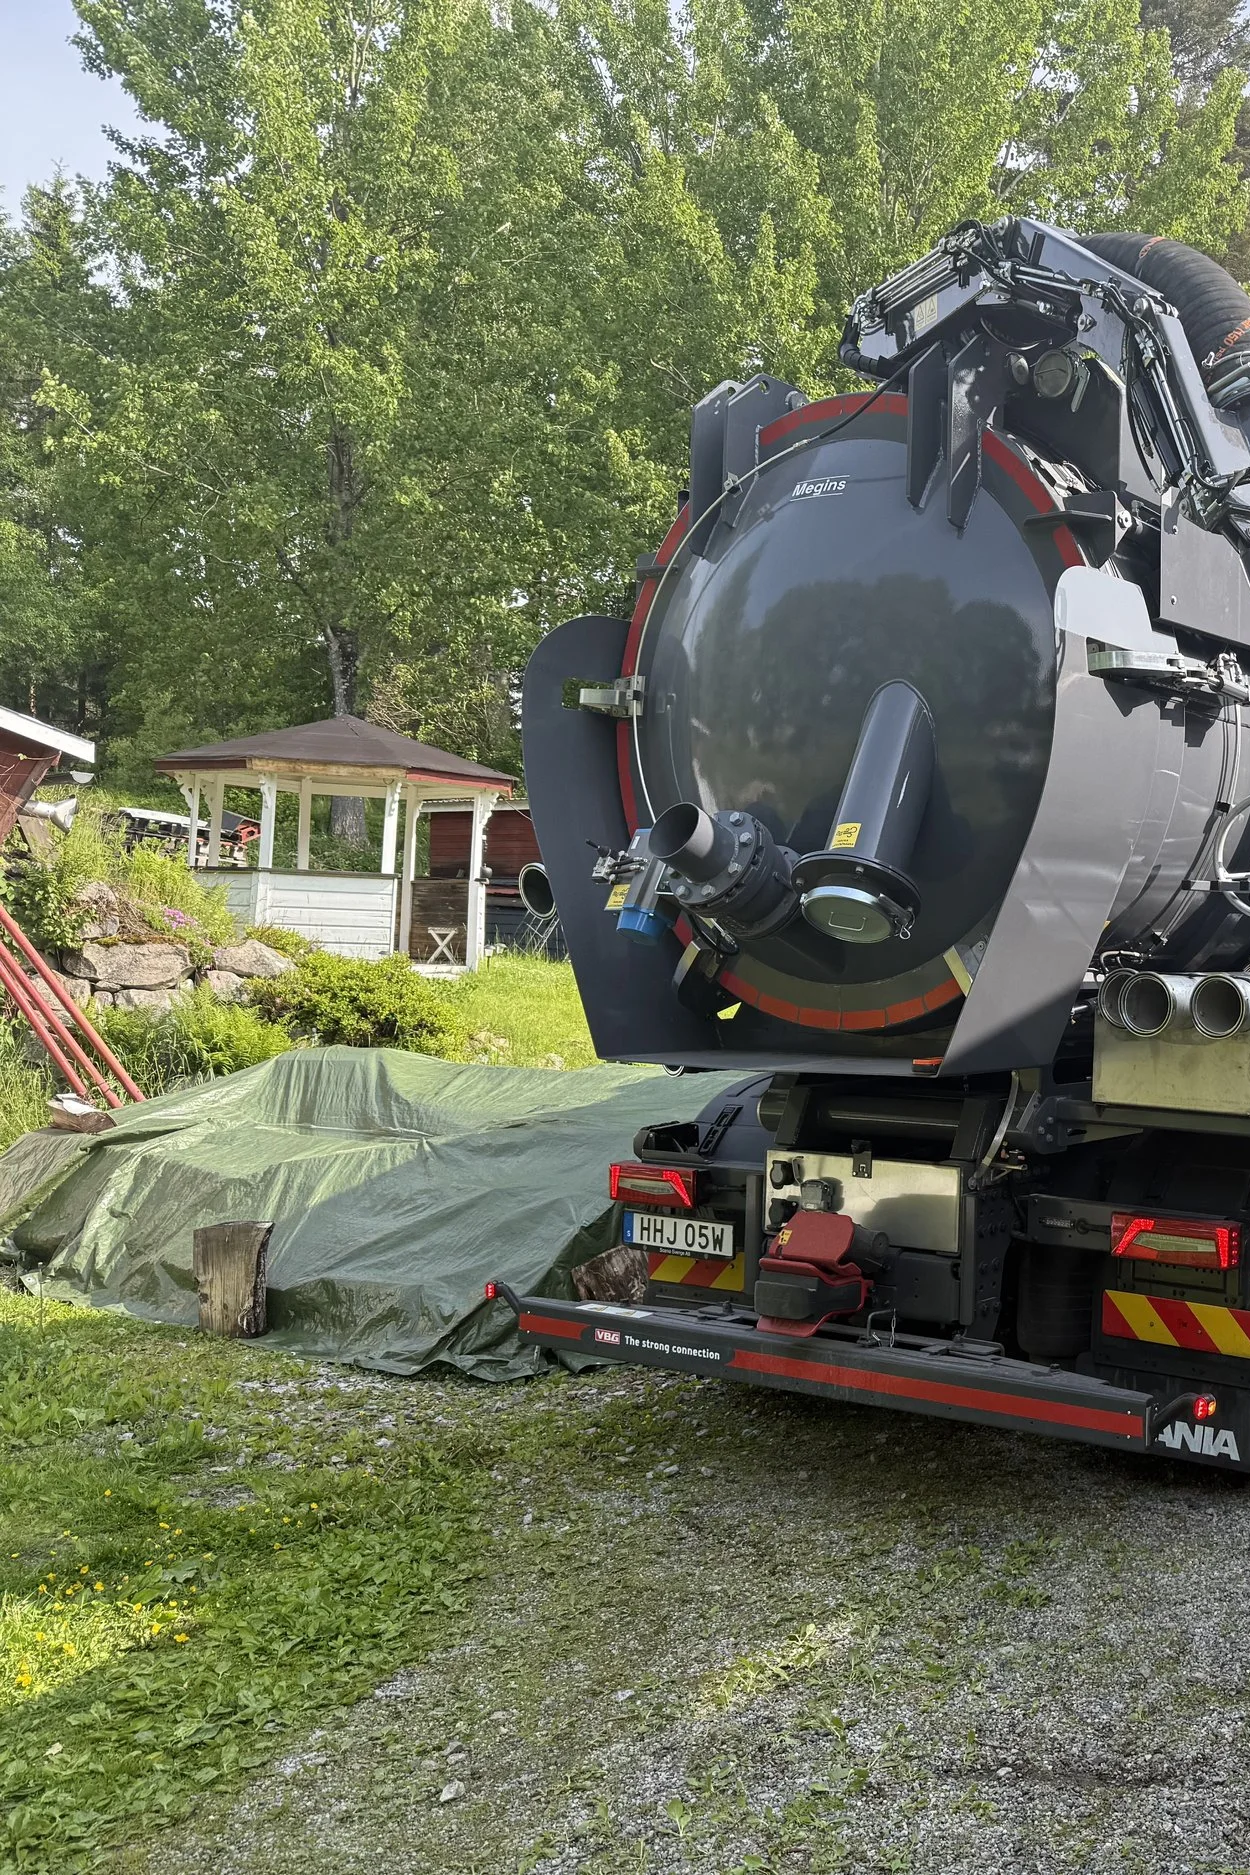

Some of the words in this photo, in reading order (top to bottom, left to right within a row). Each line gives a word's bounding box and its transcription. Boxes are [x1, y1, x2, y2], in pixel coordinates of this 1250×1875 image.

[791, 479, 847, 497] Megins
[640, 1216, 677, 1245] HHJ
[684, 1223, 725, 1252] 05W
[596, 1330, 620, 1342] VBG
[624, 1335, 640, 1347] The
[641, 1339, 670, 1354] strong
[671, 1345, 720, 1361] connection
[1156, 1420, 1241, 1462] ANIA
